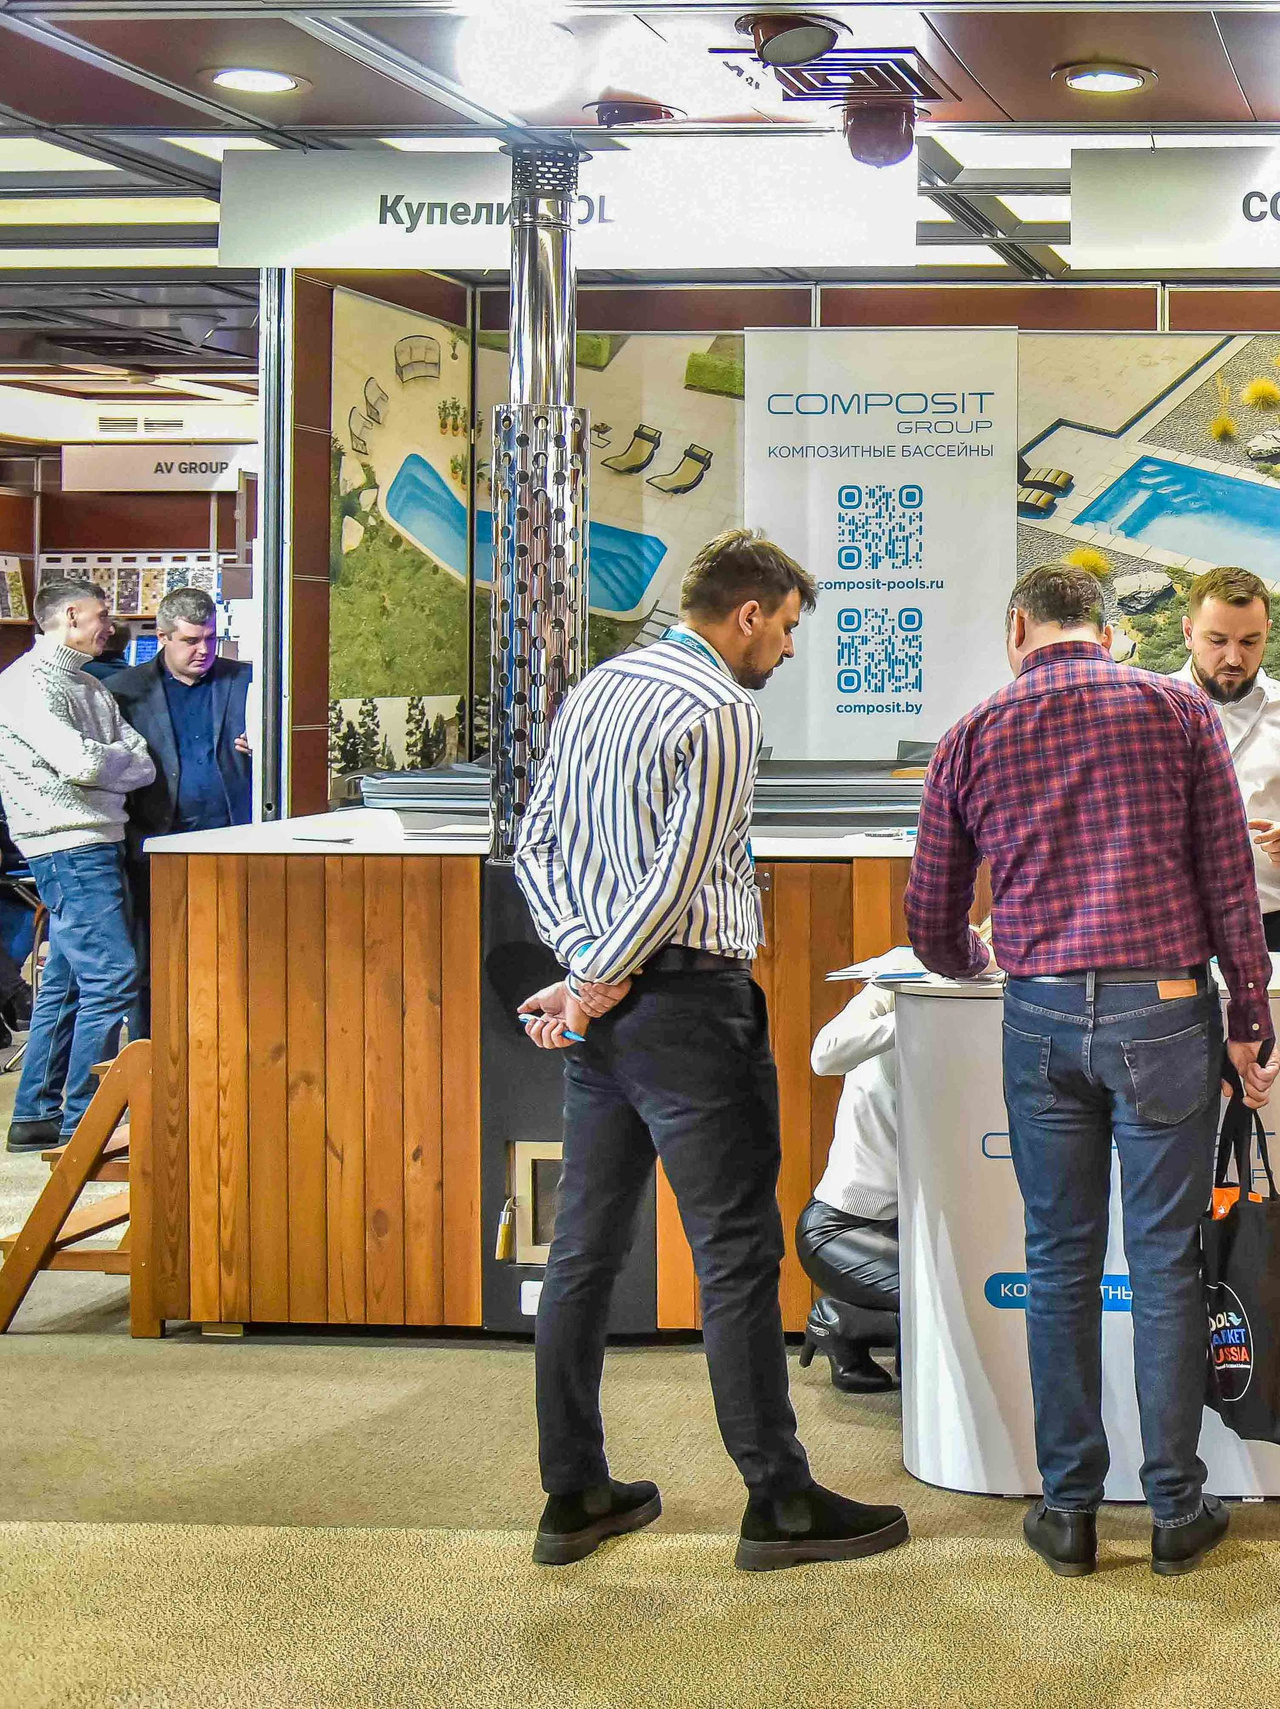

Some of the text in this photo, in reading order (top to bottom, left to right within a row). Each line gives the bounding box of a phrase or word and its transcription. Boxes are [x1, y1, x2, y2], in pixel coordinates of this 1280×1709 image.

[767, 392, 995, 415] COMPOSIT
[896, 420, 994, 435] GROUP
[768, 440, 994, 459] КОМПОЗИТНЫЕ БАССЕЙНЫ
[153, 462, 229, 475] AV GROUP
[818, 578, 944, 592] composit-pools.ru
[836, 702, 923, 716] composit.by
